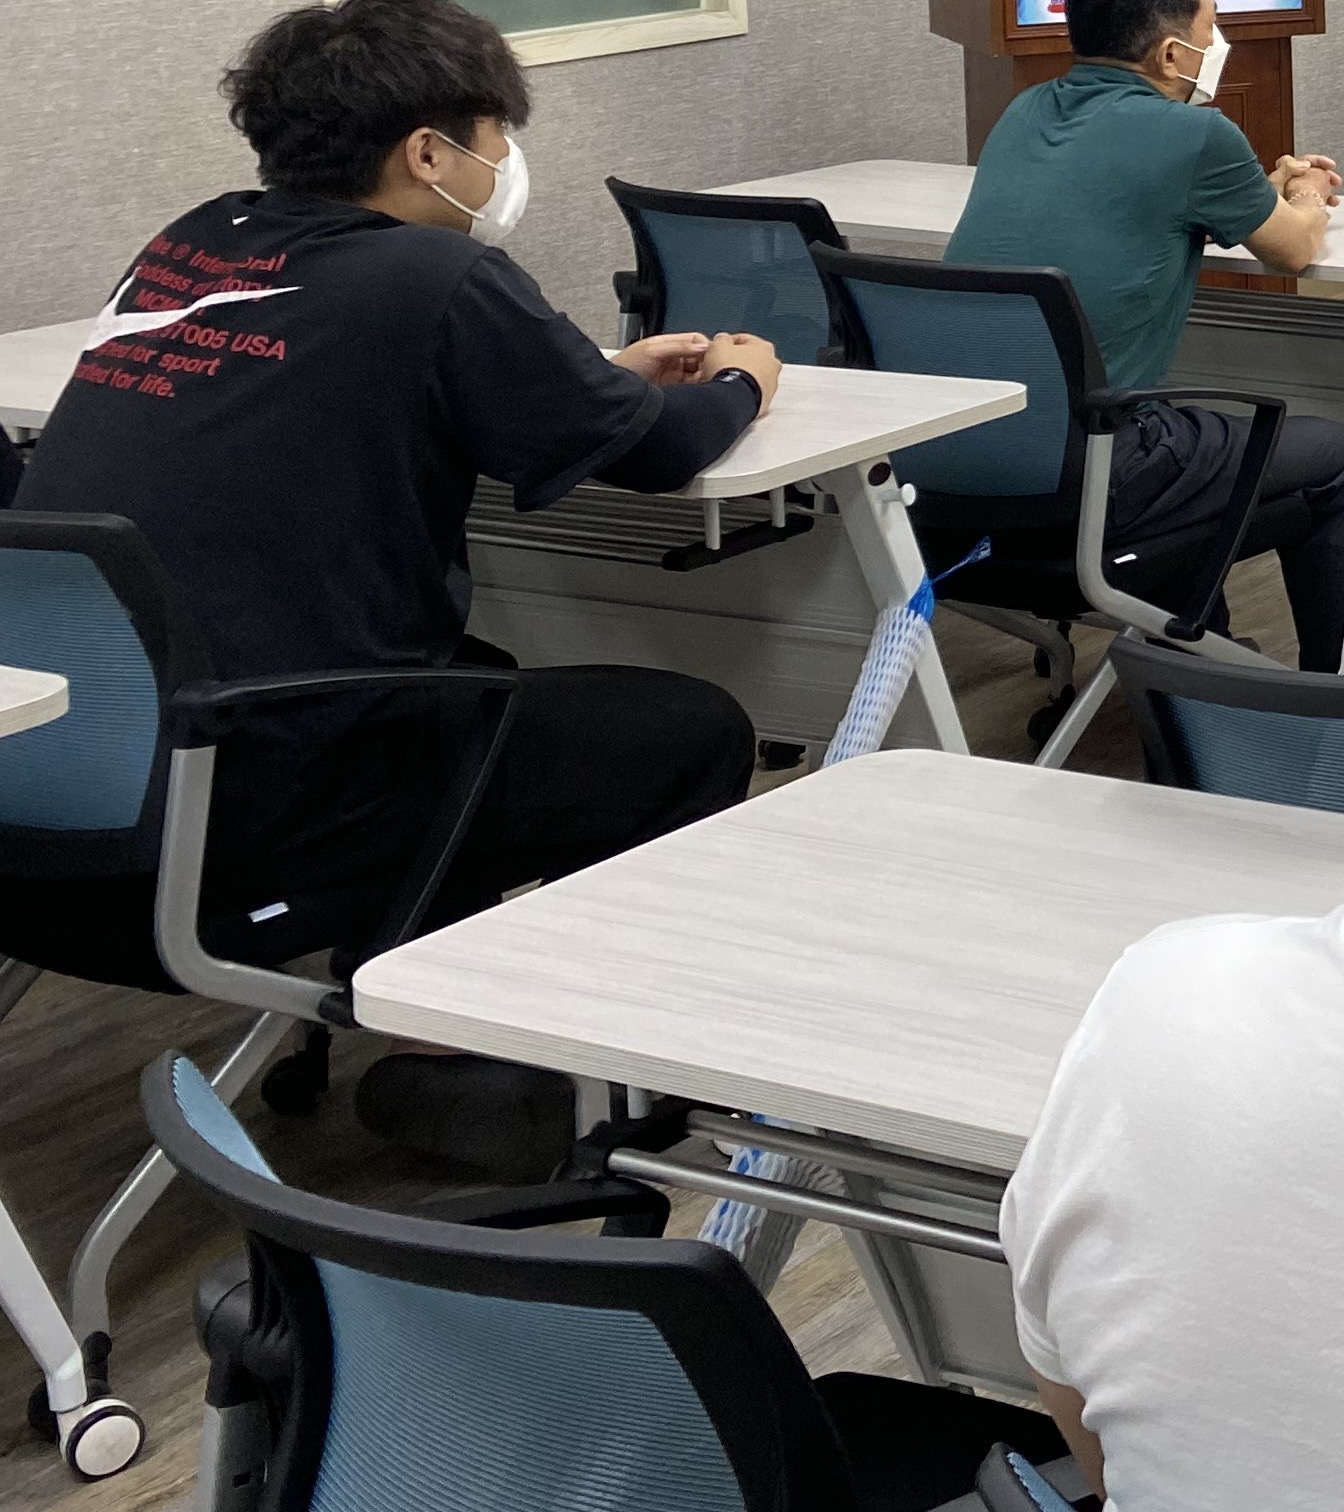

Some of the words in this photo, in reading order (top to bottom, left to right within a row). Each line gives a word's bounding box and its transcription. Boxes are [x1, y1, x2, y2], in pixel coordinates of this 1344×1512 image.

[229, 331, 286, 361] USA
[157, 353, 222, 377] sport
[137, 372, 177, 399] life.
